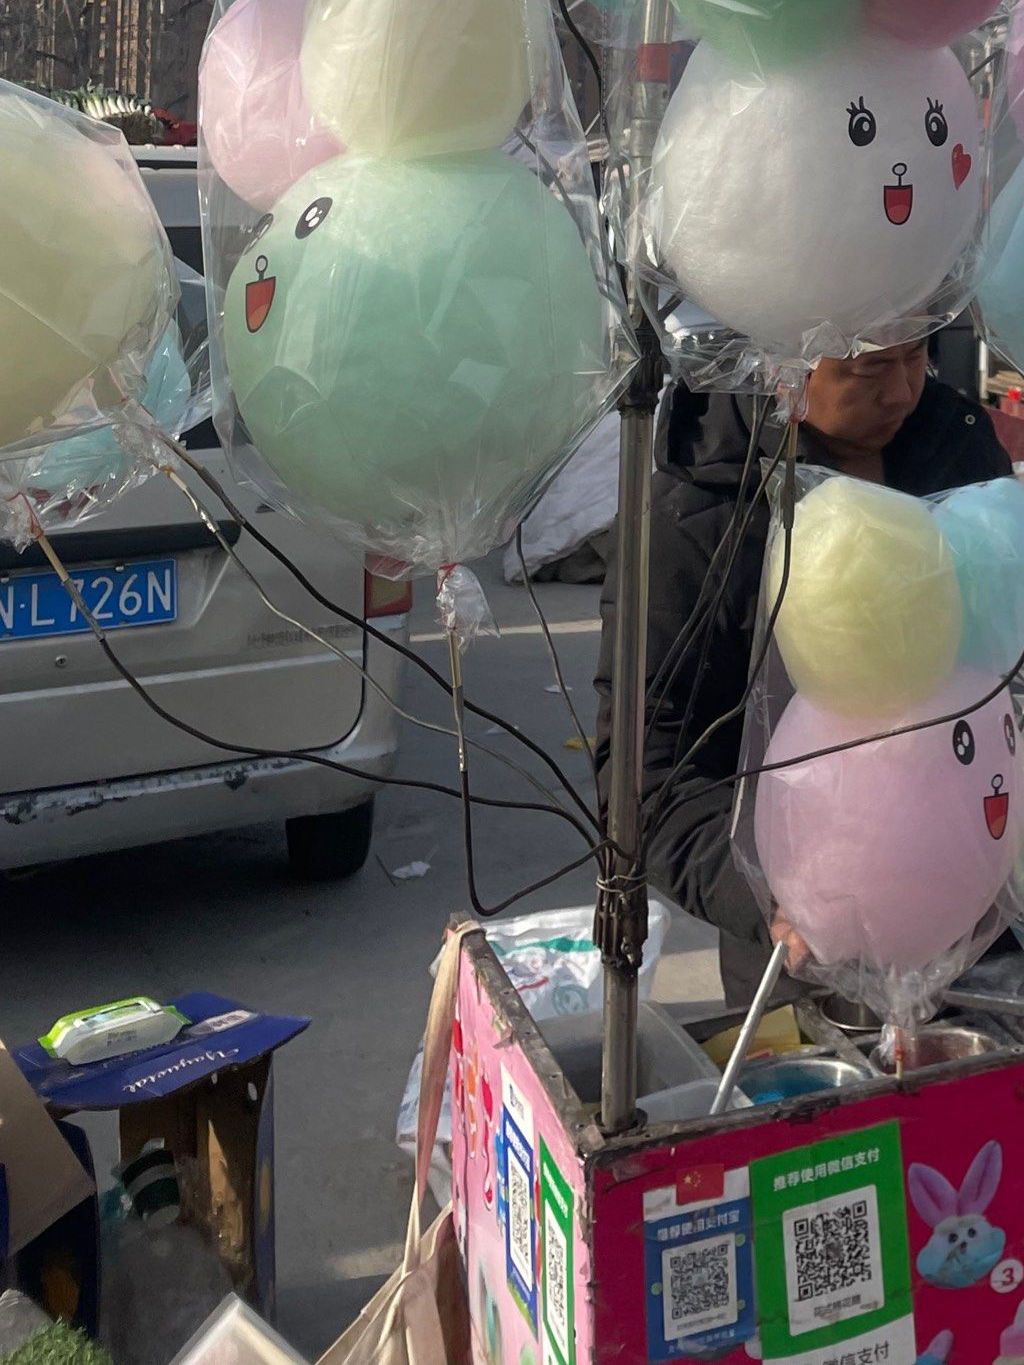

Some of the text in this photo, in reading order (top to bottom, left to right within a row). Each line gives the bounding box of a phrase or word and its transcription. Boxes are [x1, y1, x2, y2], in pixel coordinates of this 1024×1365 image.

[772, 1147, 880, 1192] 推荐使用微信支付
[1002, 1266, 1015, 1286] 3
